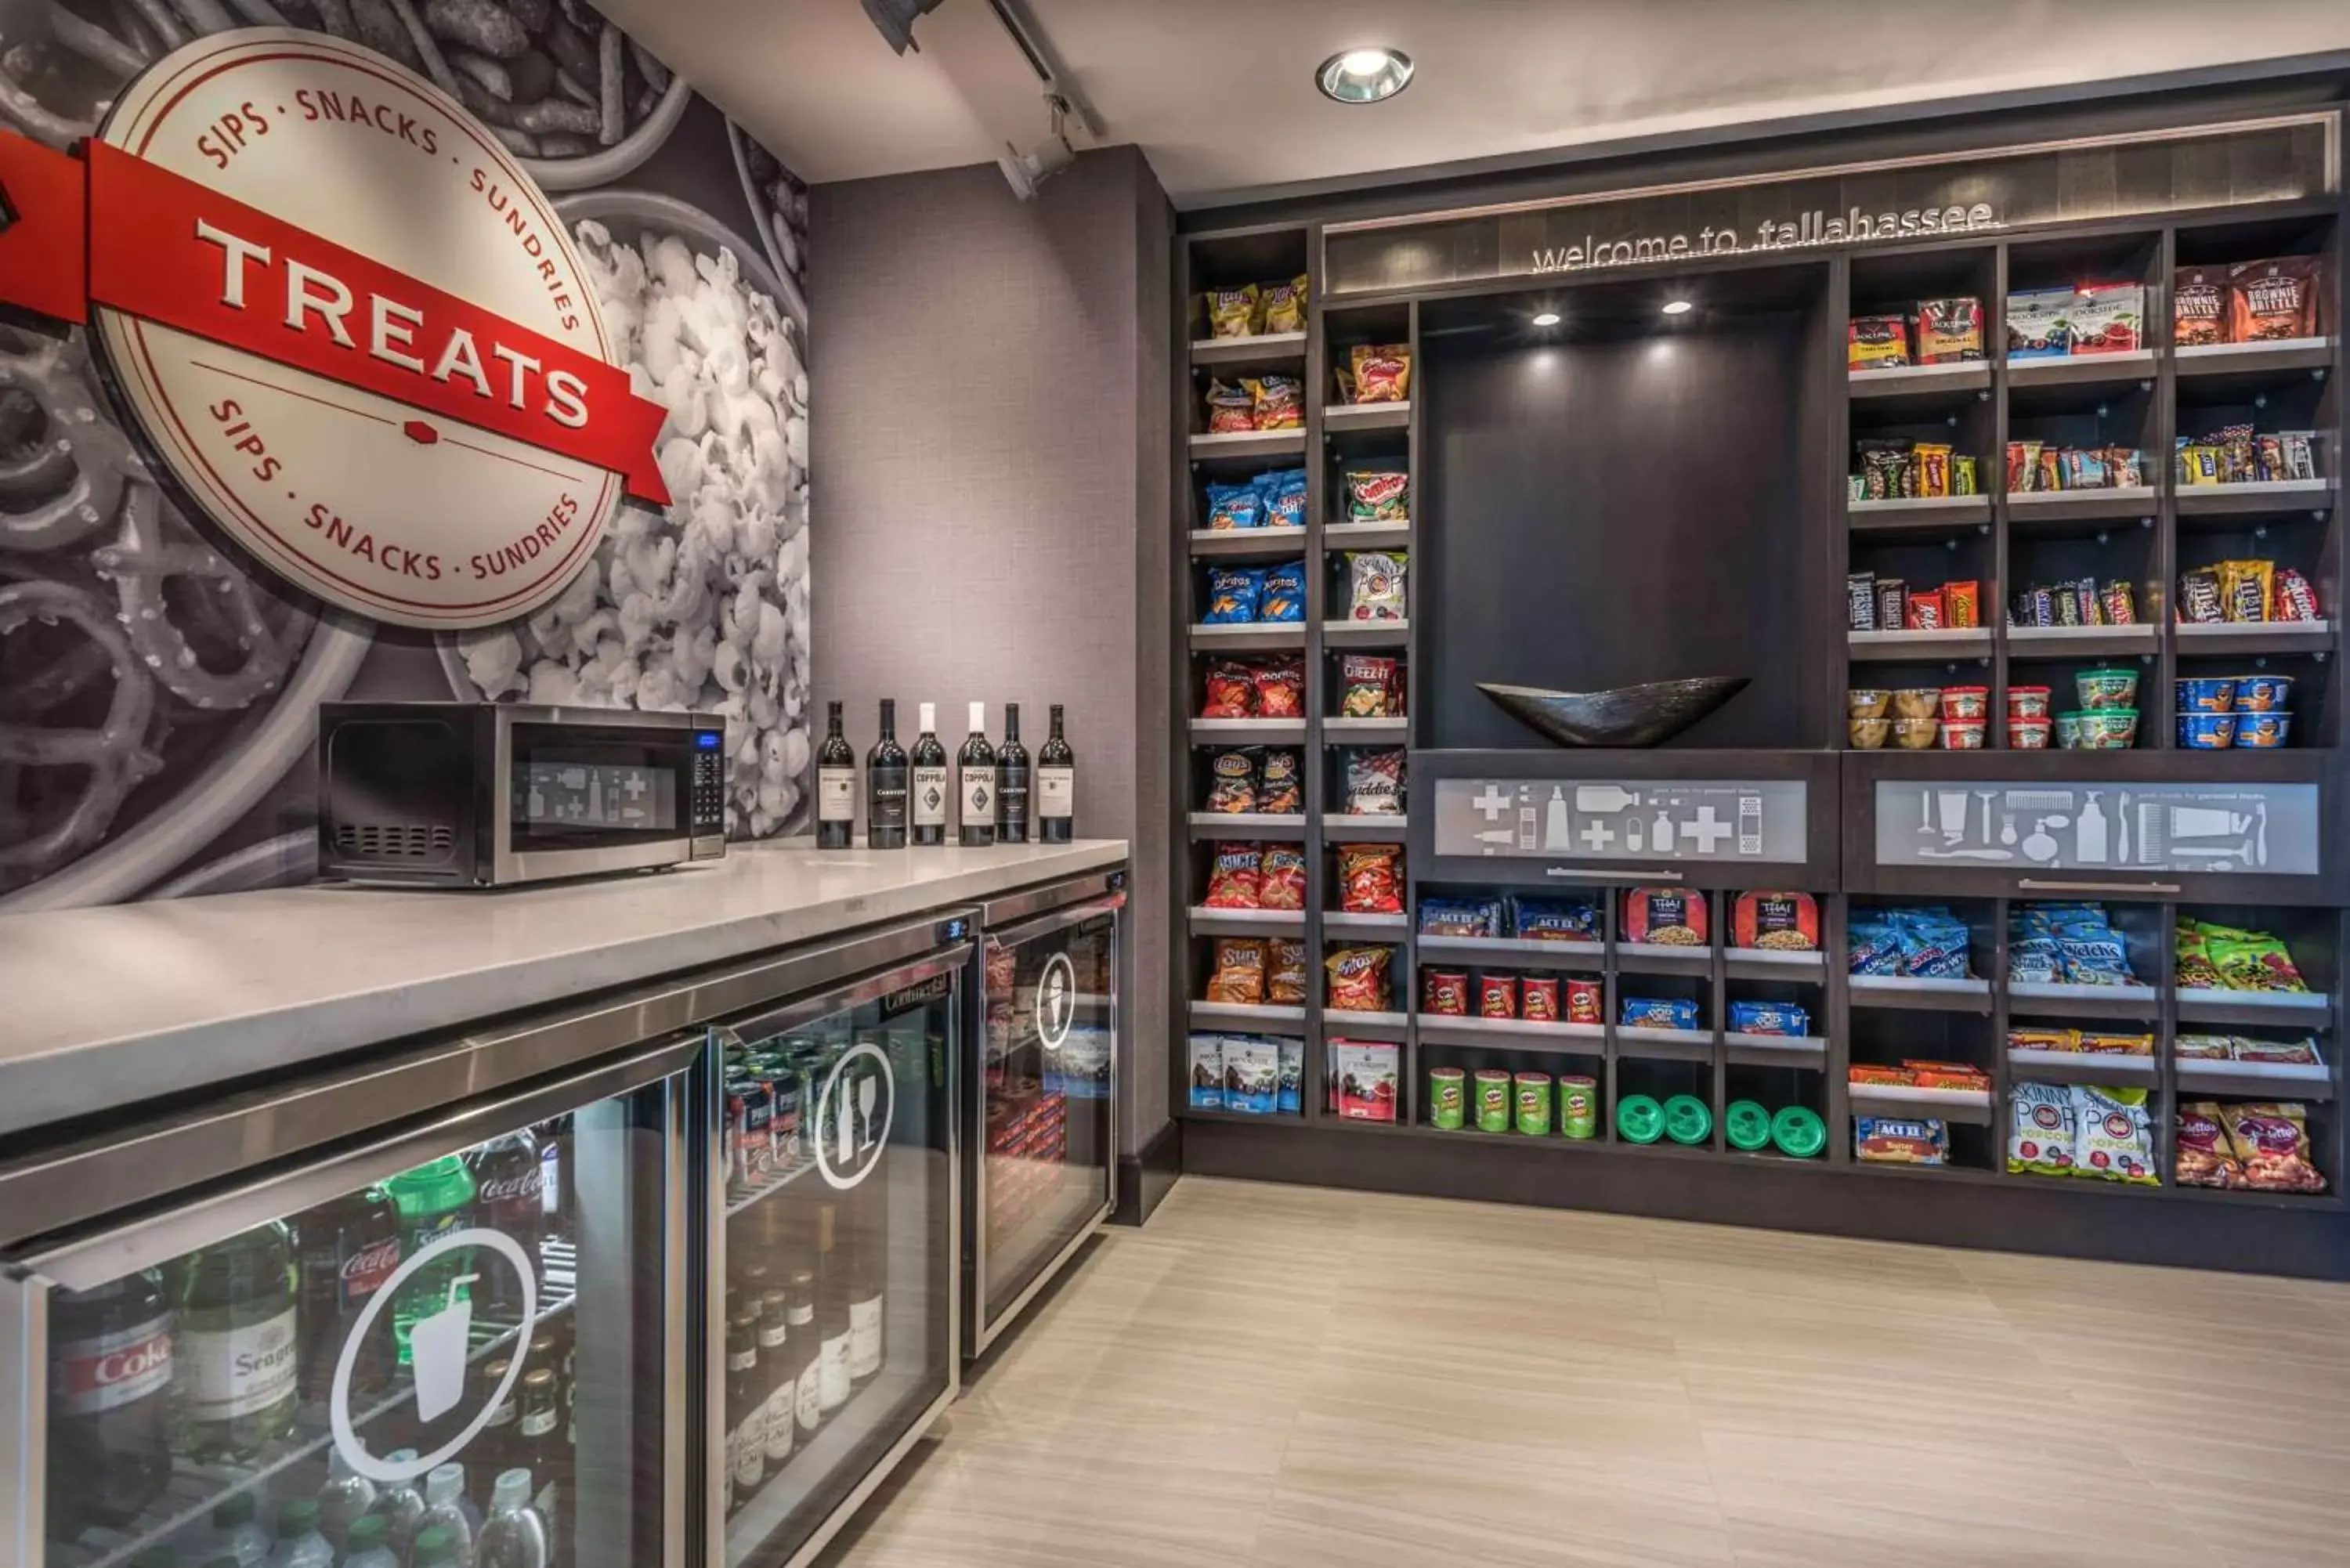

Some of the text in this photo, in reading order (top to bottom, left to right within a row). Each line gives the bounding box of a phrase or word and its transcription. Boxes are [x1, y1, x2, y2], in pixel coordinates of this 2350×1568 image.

[197, 89, 580, 332] SIPS SNACKS SUNDRIES
[1532, 202, 1992, 273] welcome to tallahassee
[2247, 286, 2300, 302] BROWNIE
[2249, 298, 2301, 313] BRITTLE
[195, 217, 591, 429] TREATS
[210, 398, 580, 581] SIPS SNACKS SUNDRIES
[916, 773, 945, 782] COPPOLA
[964, 773, 994, 782] COPPOLA
[2060, 943, 2120, 957] Welch's
[2015, 1083, 2072, 1105] SKINNY
[1881, 1124, 1904, 1136] ACT
[480, 1167, 544, 1204] Coca-Col
[95, 1334, 172, 1386] Coke
[236, 1341, 298, 1377] Seagr
